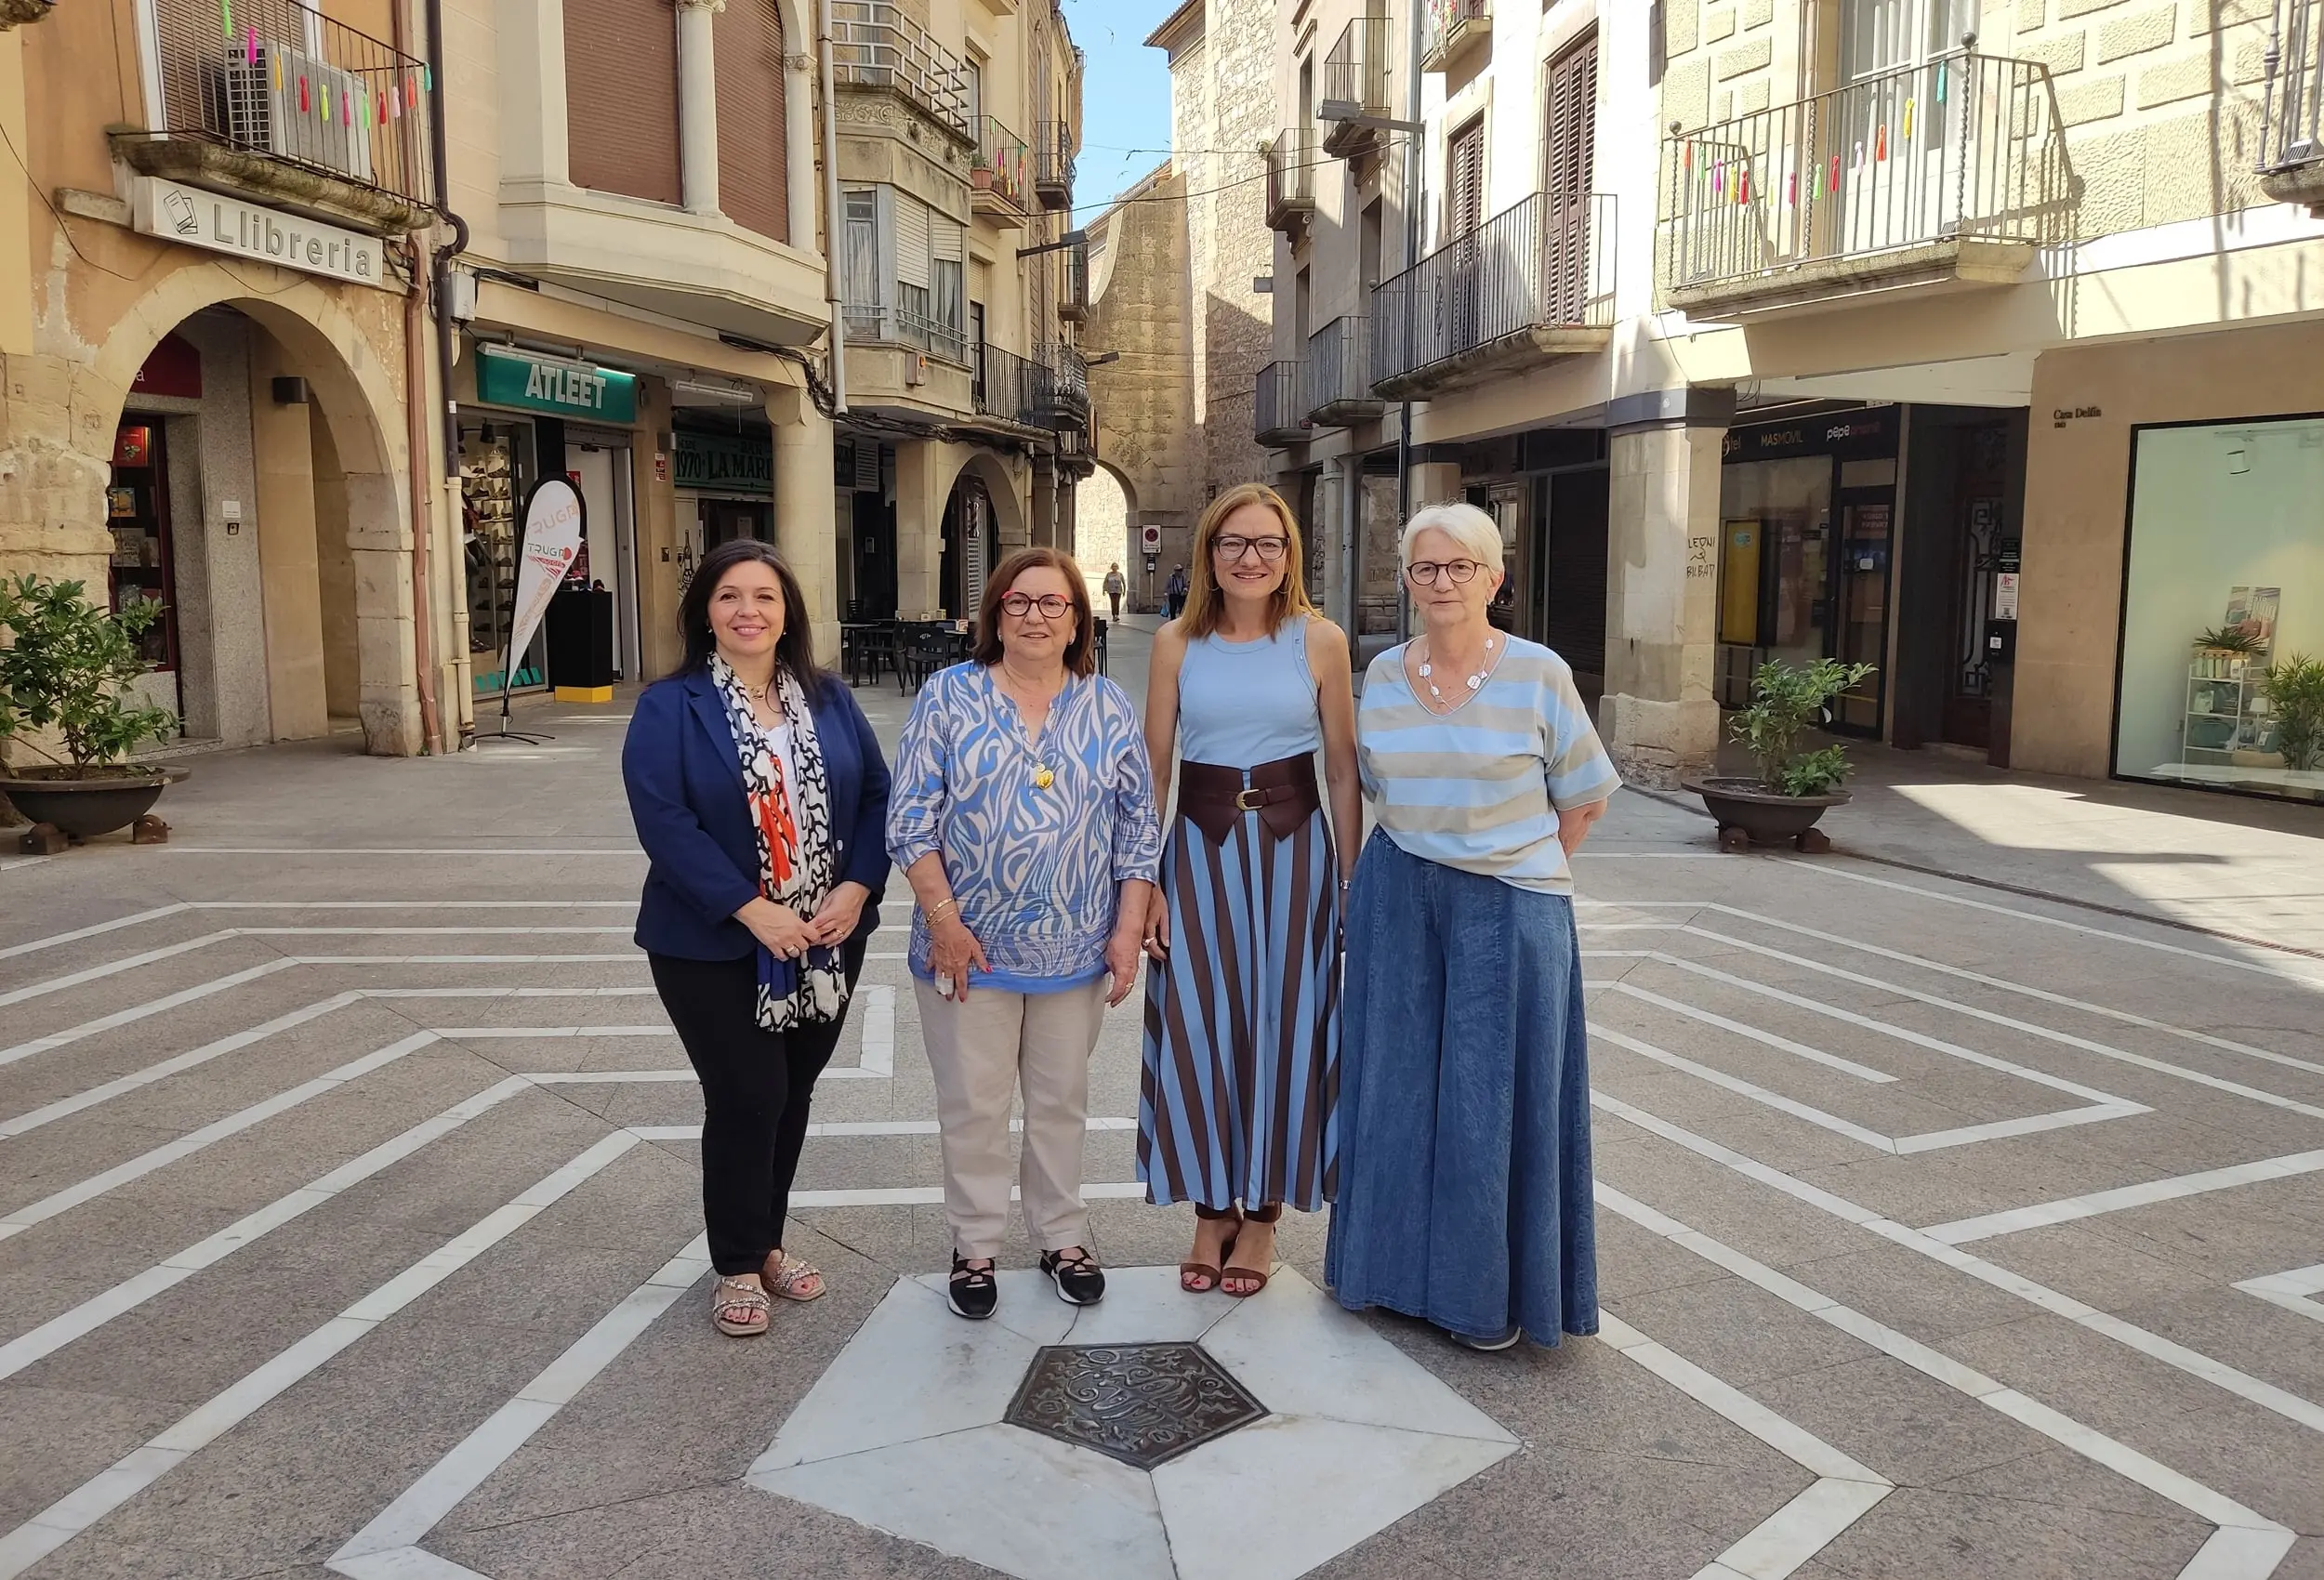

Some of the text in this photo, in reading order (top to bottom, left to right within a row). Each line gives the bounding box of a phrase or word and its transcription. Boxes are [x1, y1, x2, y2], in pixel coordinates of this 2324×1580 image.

[213, 203, 371, 277] Llibreria
[524, 363, 606, 410] ATLEET
[675, 450, 702, 479] 1970
[707, 450, 730, 480] LA
